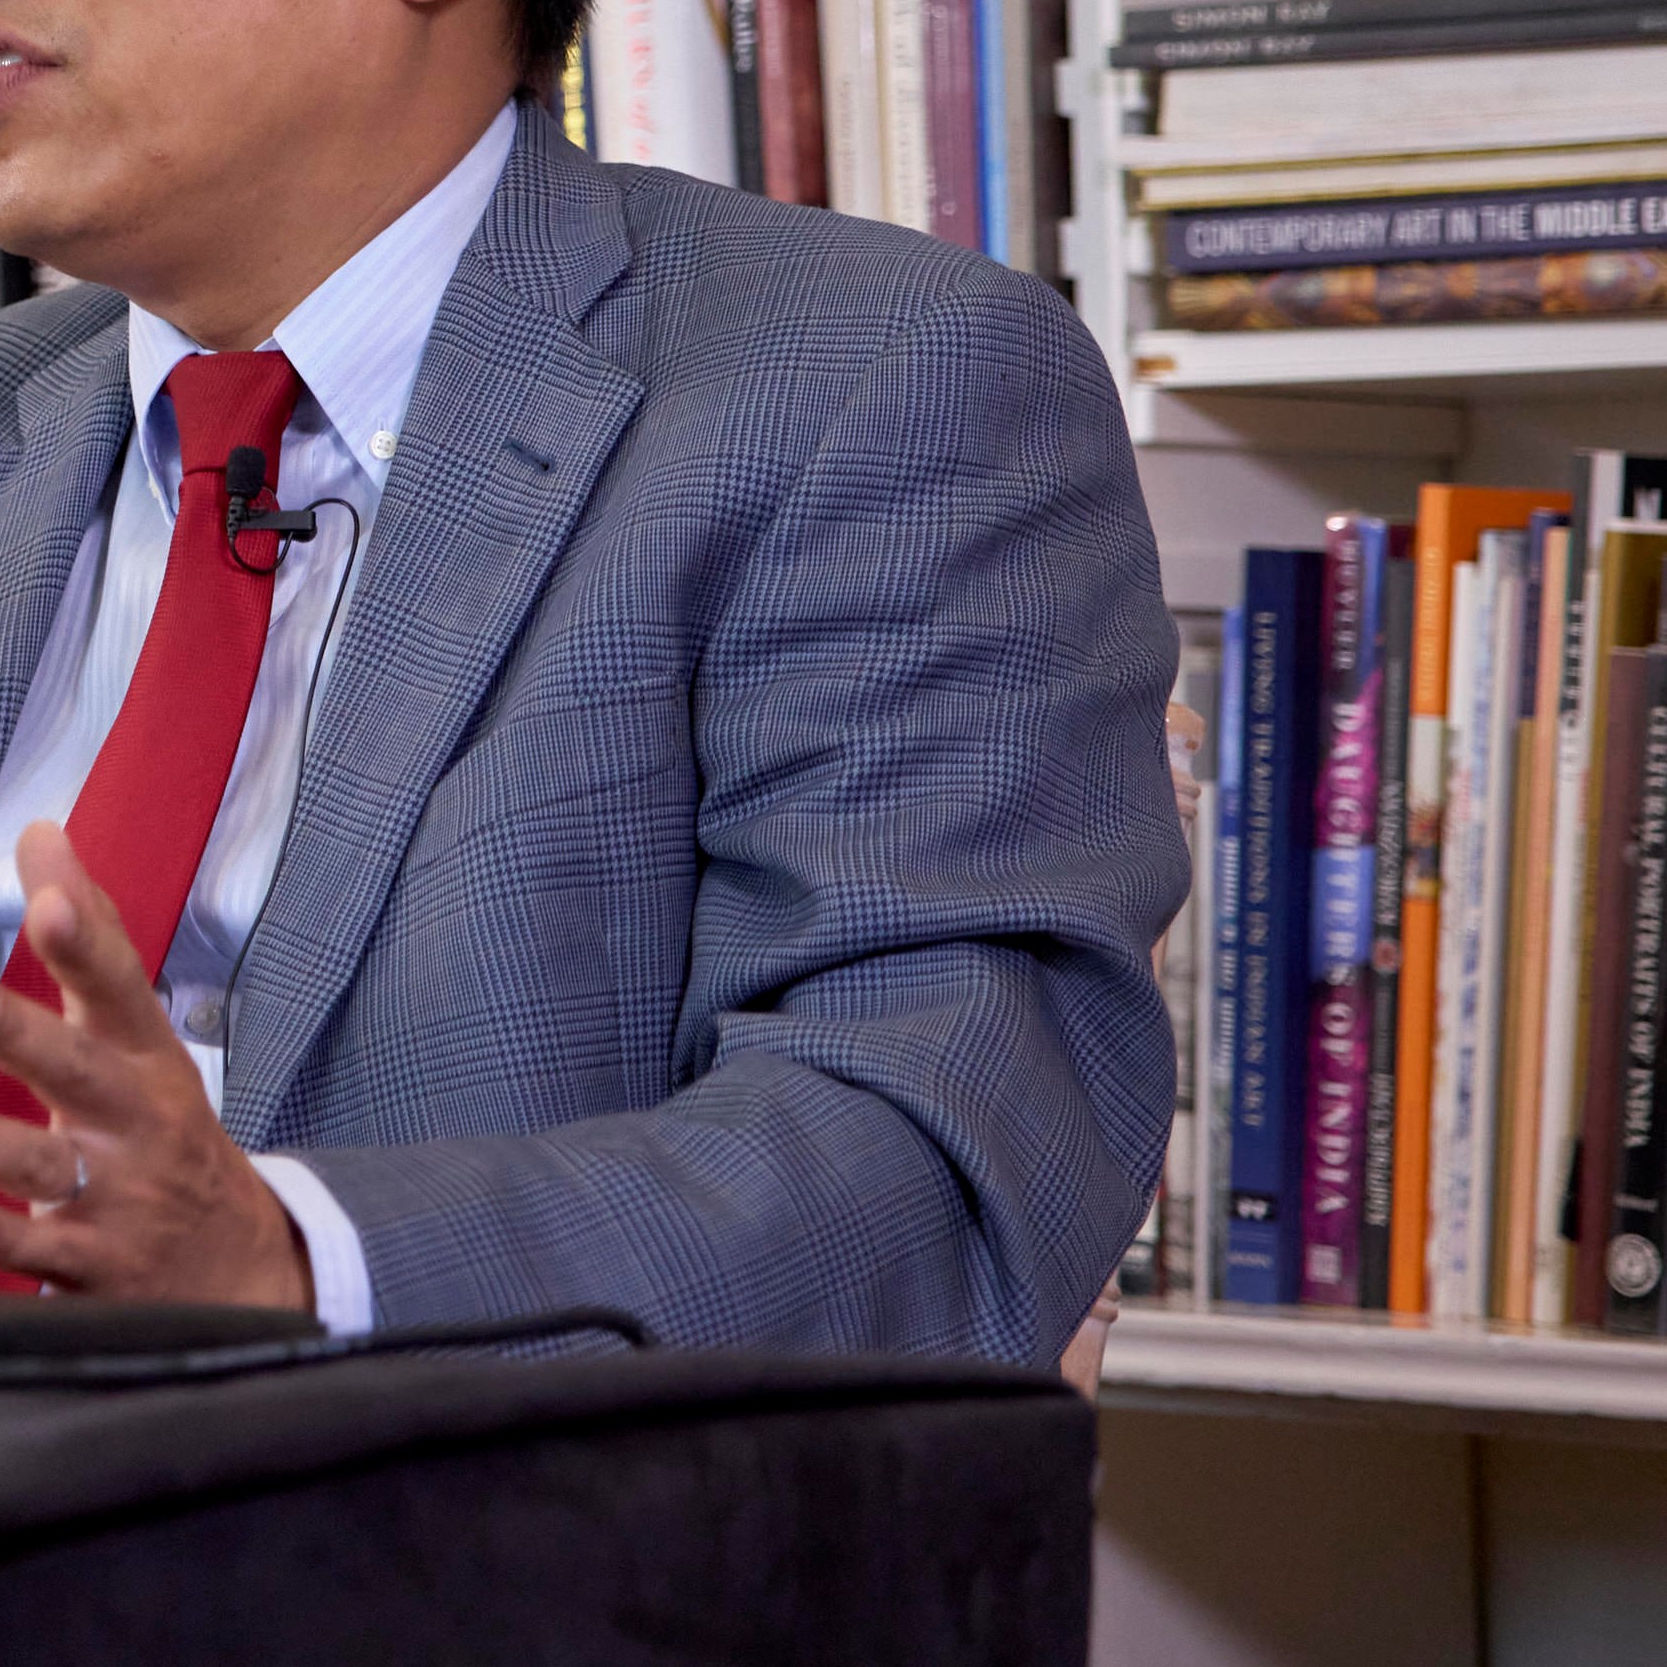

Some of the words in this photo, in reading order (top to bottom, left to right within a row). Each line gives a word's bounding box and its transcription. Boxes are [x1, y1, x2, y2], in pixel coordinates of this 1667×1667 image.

[1184, 214, 1387, 259] CONTEMPORARY
[1390, 208, 1444, 248] ART
[1445, 210, 1476, 244] IN
[1481, 203, 1530, 241] THE
[1533, 197, 1639, 238] MIDDLE
[1253, 610, 1278, 714] LIVING
[1247, 722, 1276, 904] TRADITIONS
[1324, 702, 1365, 985] DAUGHTERS
[1245, 911, 1268, 947] IN
[1630, 857, 1665, 1016] PORTRAITS
[1243, 954, 1269, 1064] INDIAN
[1320, 1002, 1356, 1067] OF
[1629, 1021, 1657, 1062] OF
[1242, 1069, 1266, 1128] ART
[1624, 1068, 1654, 1148] INDIA
[1312, 1081, 1352, 1216] INDIA
